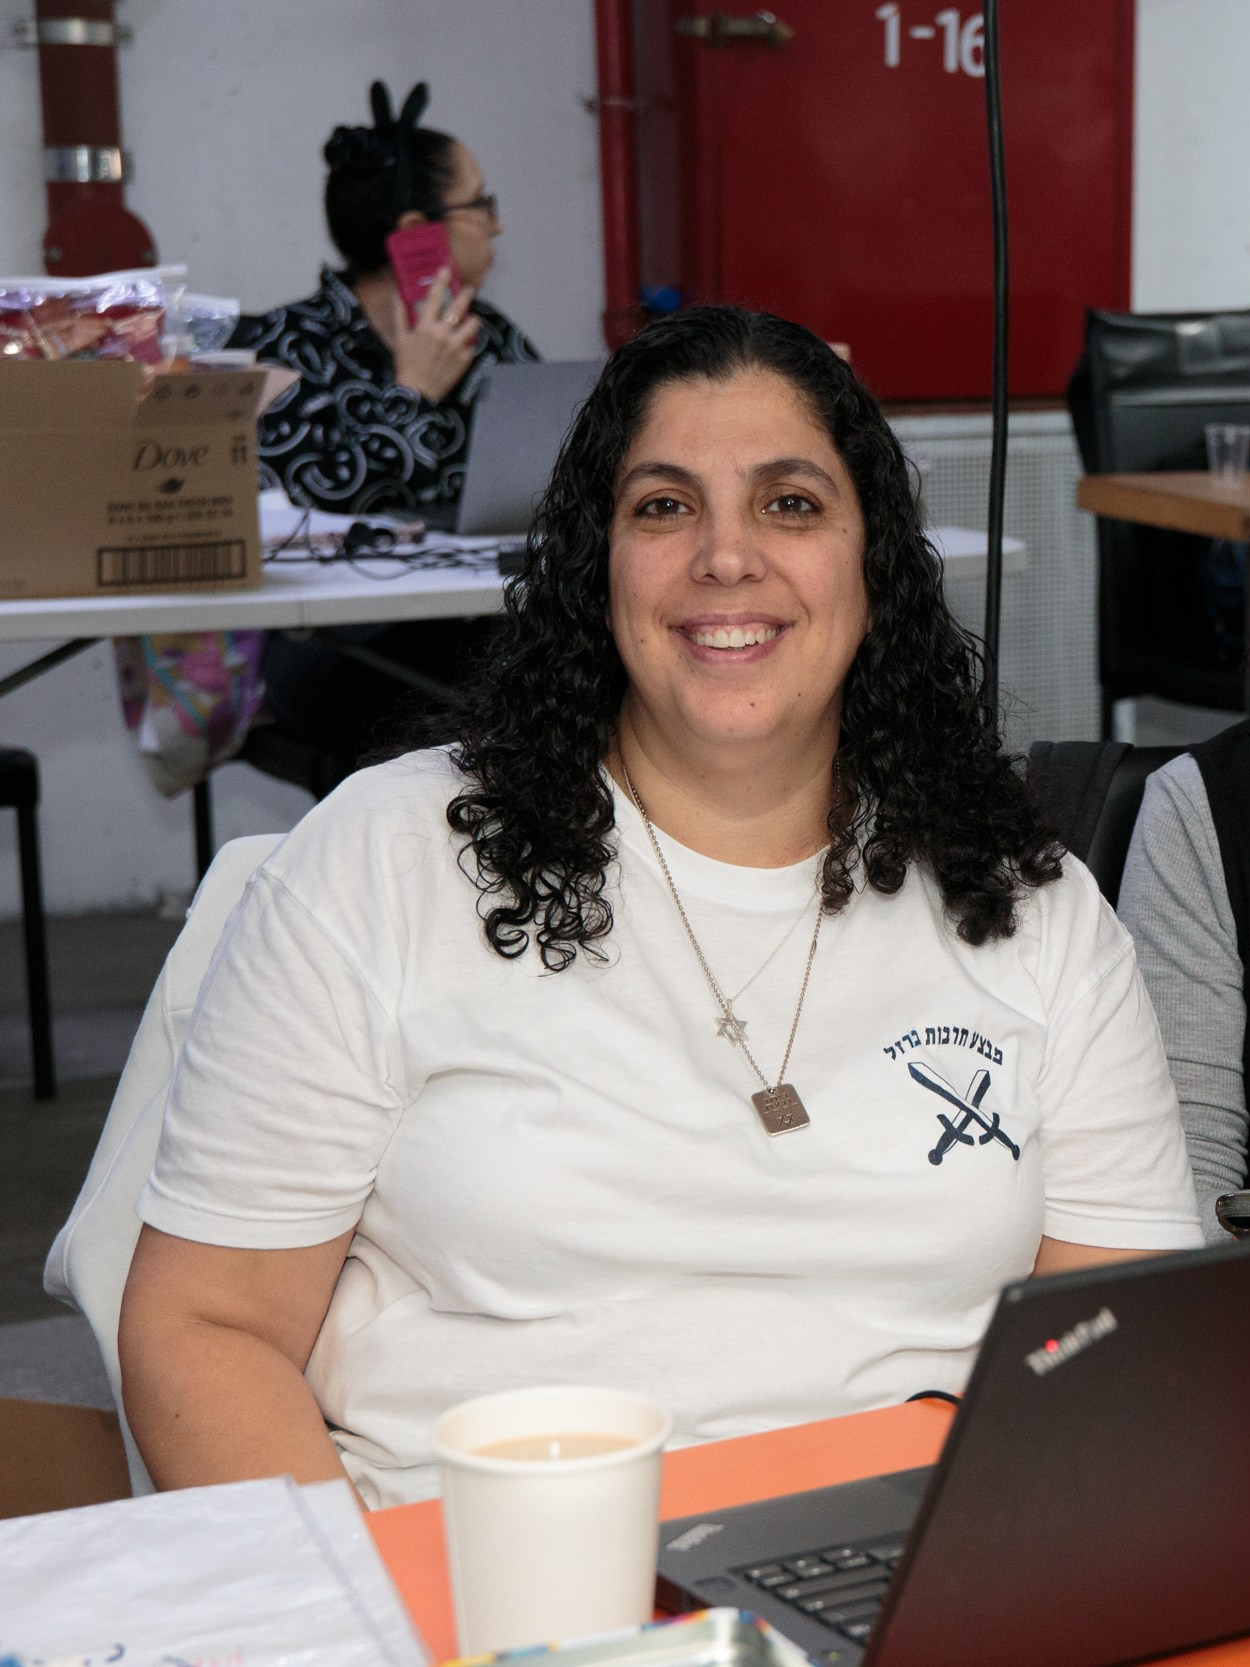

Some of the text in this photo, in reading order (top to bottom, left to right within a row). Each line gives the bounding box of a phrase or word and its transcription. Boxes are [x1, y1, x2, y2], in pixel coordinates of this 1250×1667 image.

[133, 440, 209, 472] Dove
[883, 1026, 1003, 1066] מבצע חרבות ברזל
